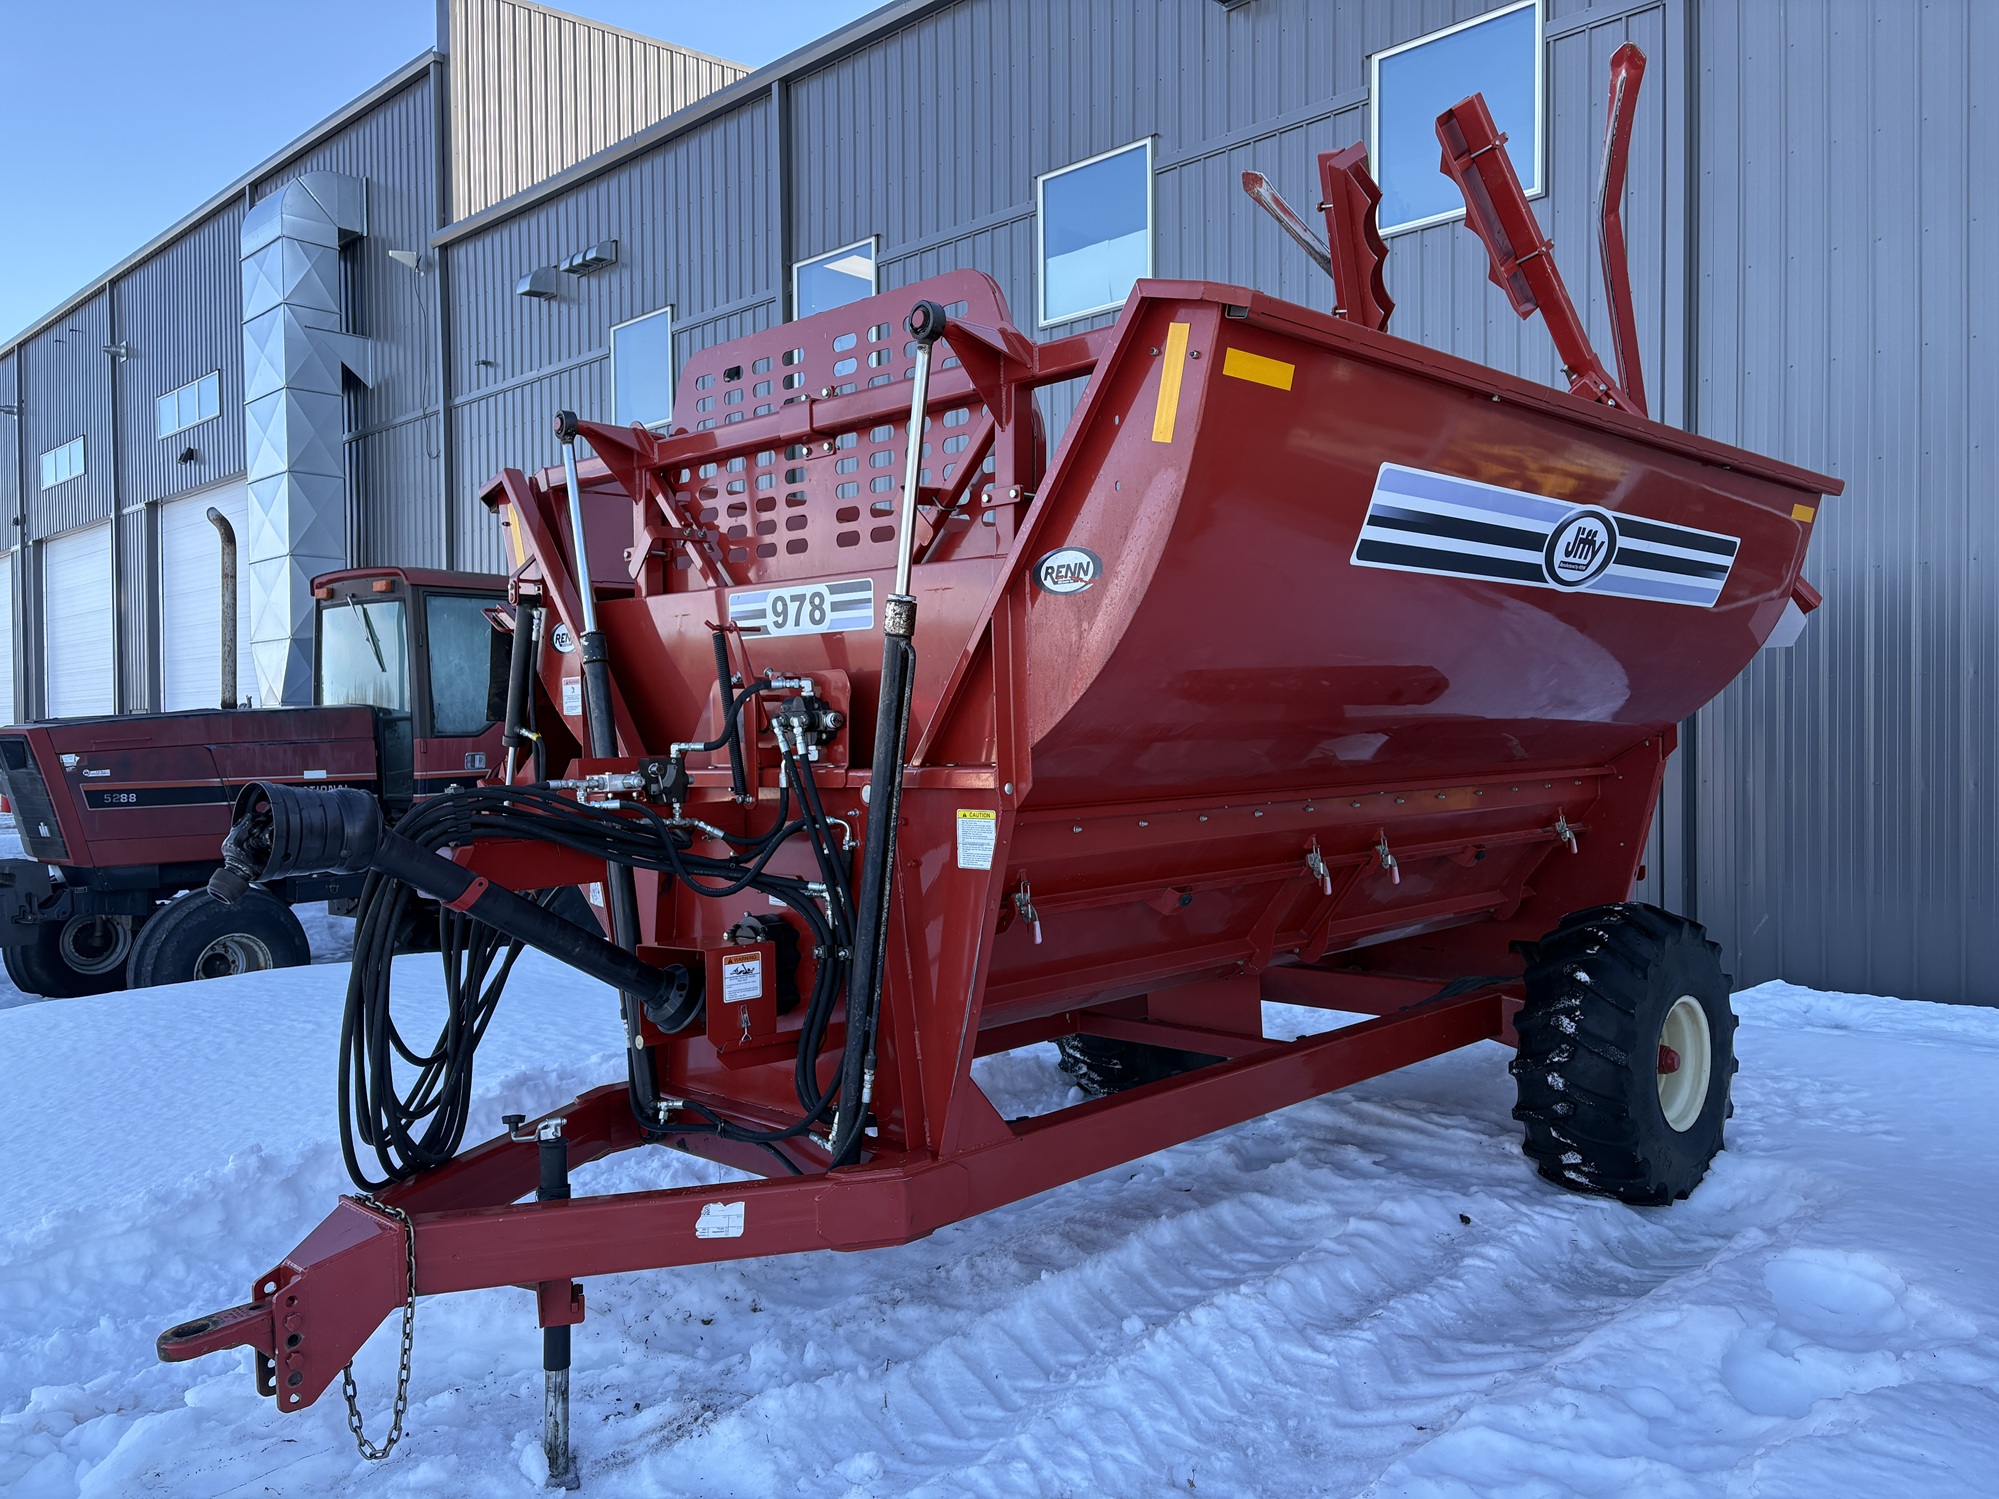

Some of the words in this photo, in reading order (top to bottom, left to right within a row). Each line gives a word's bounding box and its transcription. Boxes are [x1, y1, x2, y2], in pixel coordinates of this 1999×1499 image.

[1043, 561, 1091, 585] RENN
[771, 591, 827, 629] 978
[555, 632, 571, 647] REN
[103, 793, 137, 803] 5288
[734, 954, 757, 963] WARNING
